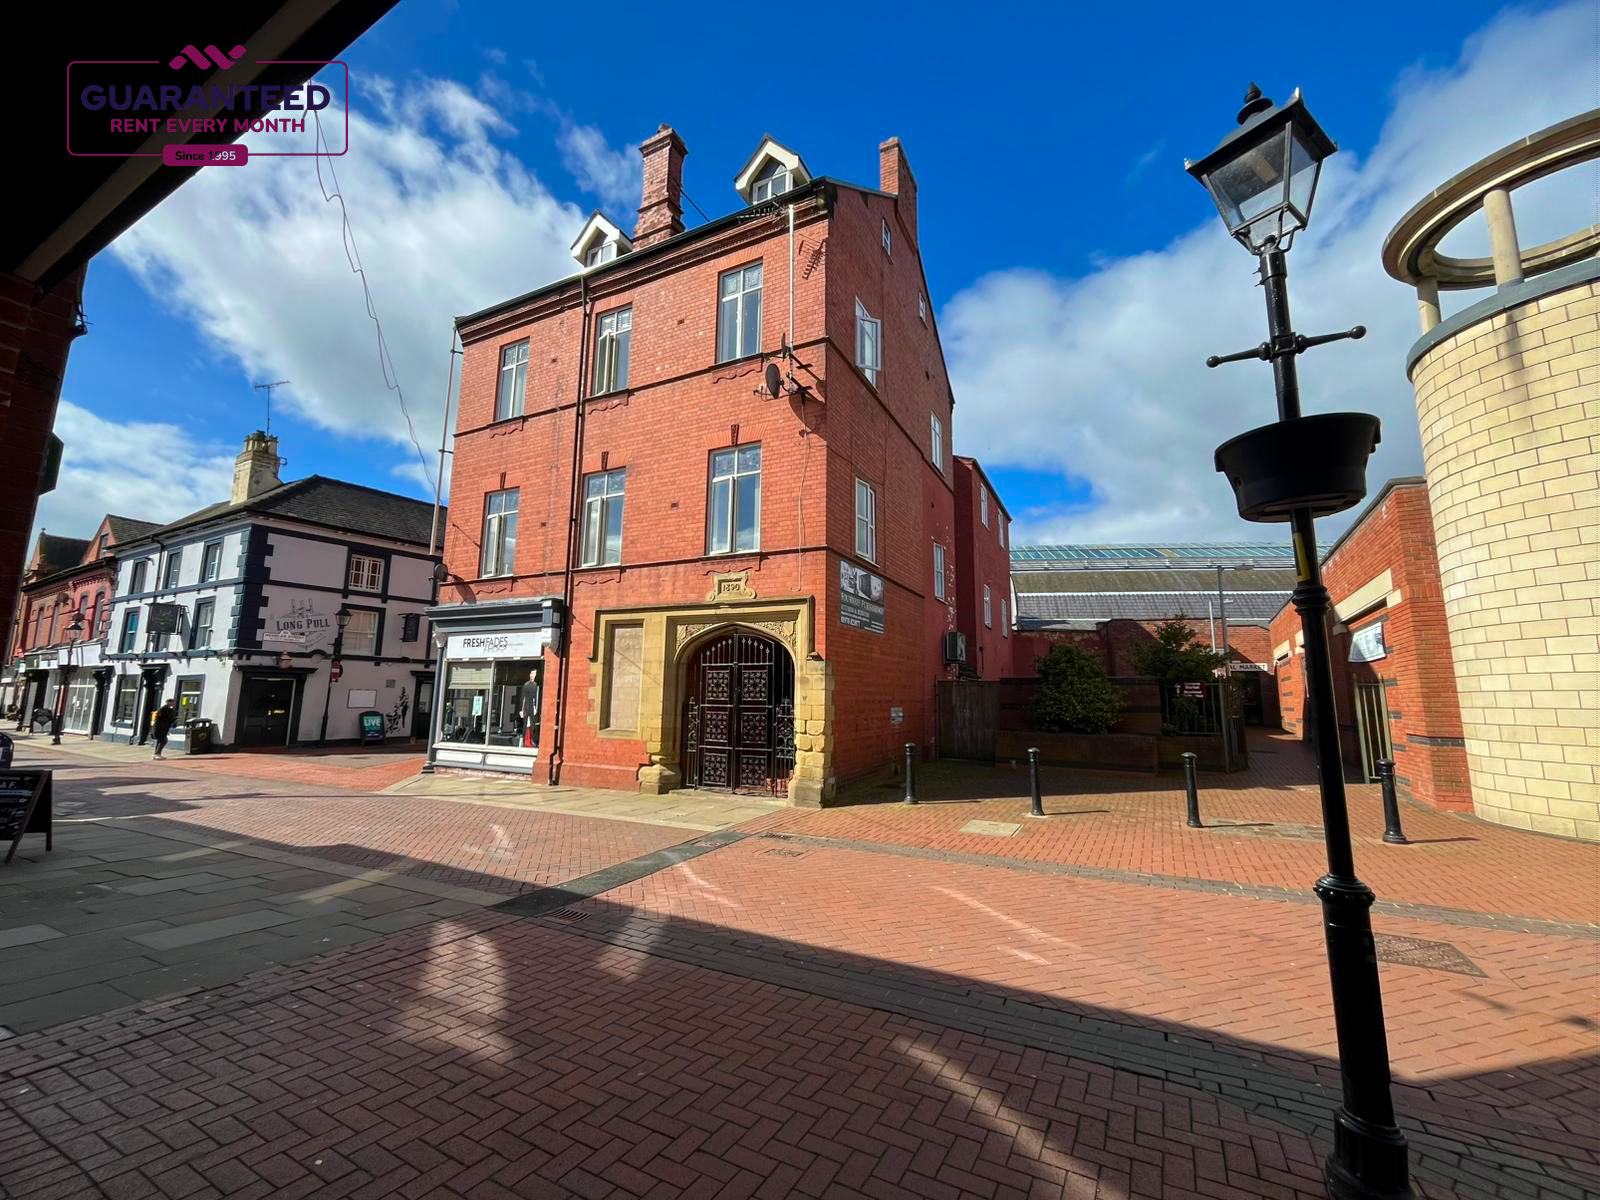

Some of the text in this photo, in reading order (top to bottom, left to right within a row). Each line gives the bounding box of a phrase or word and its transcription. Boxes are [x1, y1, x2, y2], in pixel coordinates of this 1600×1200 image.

[276, 618, 331, 631] LONG PULL
[364, 718, 381, 726] LIVE
